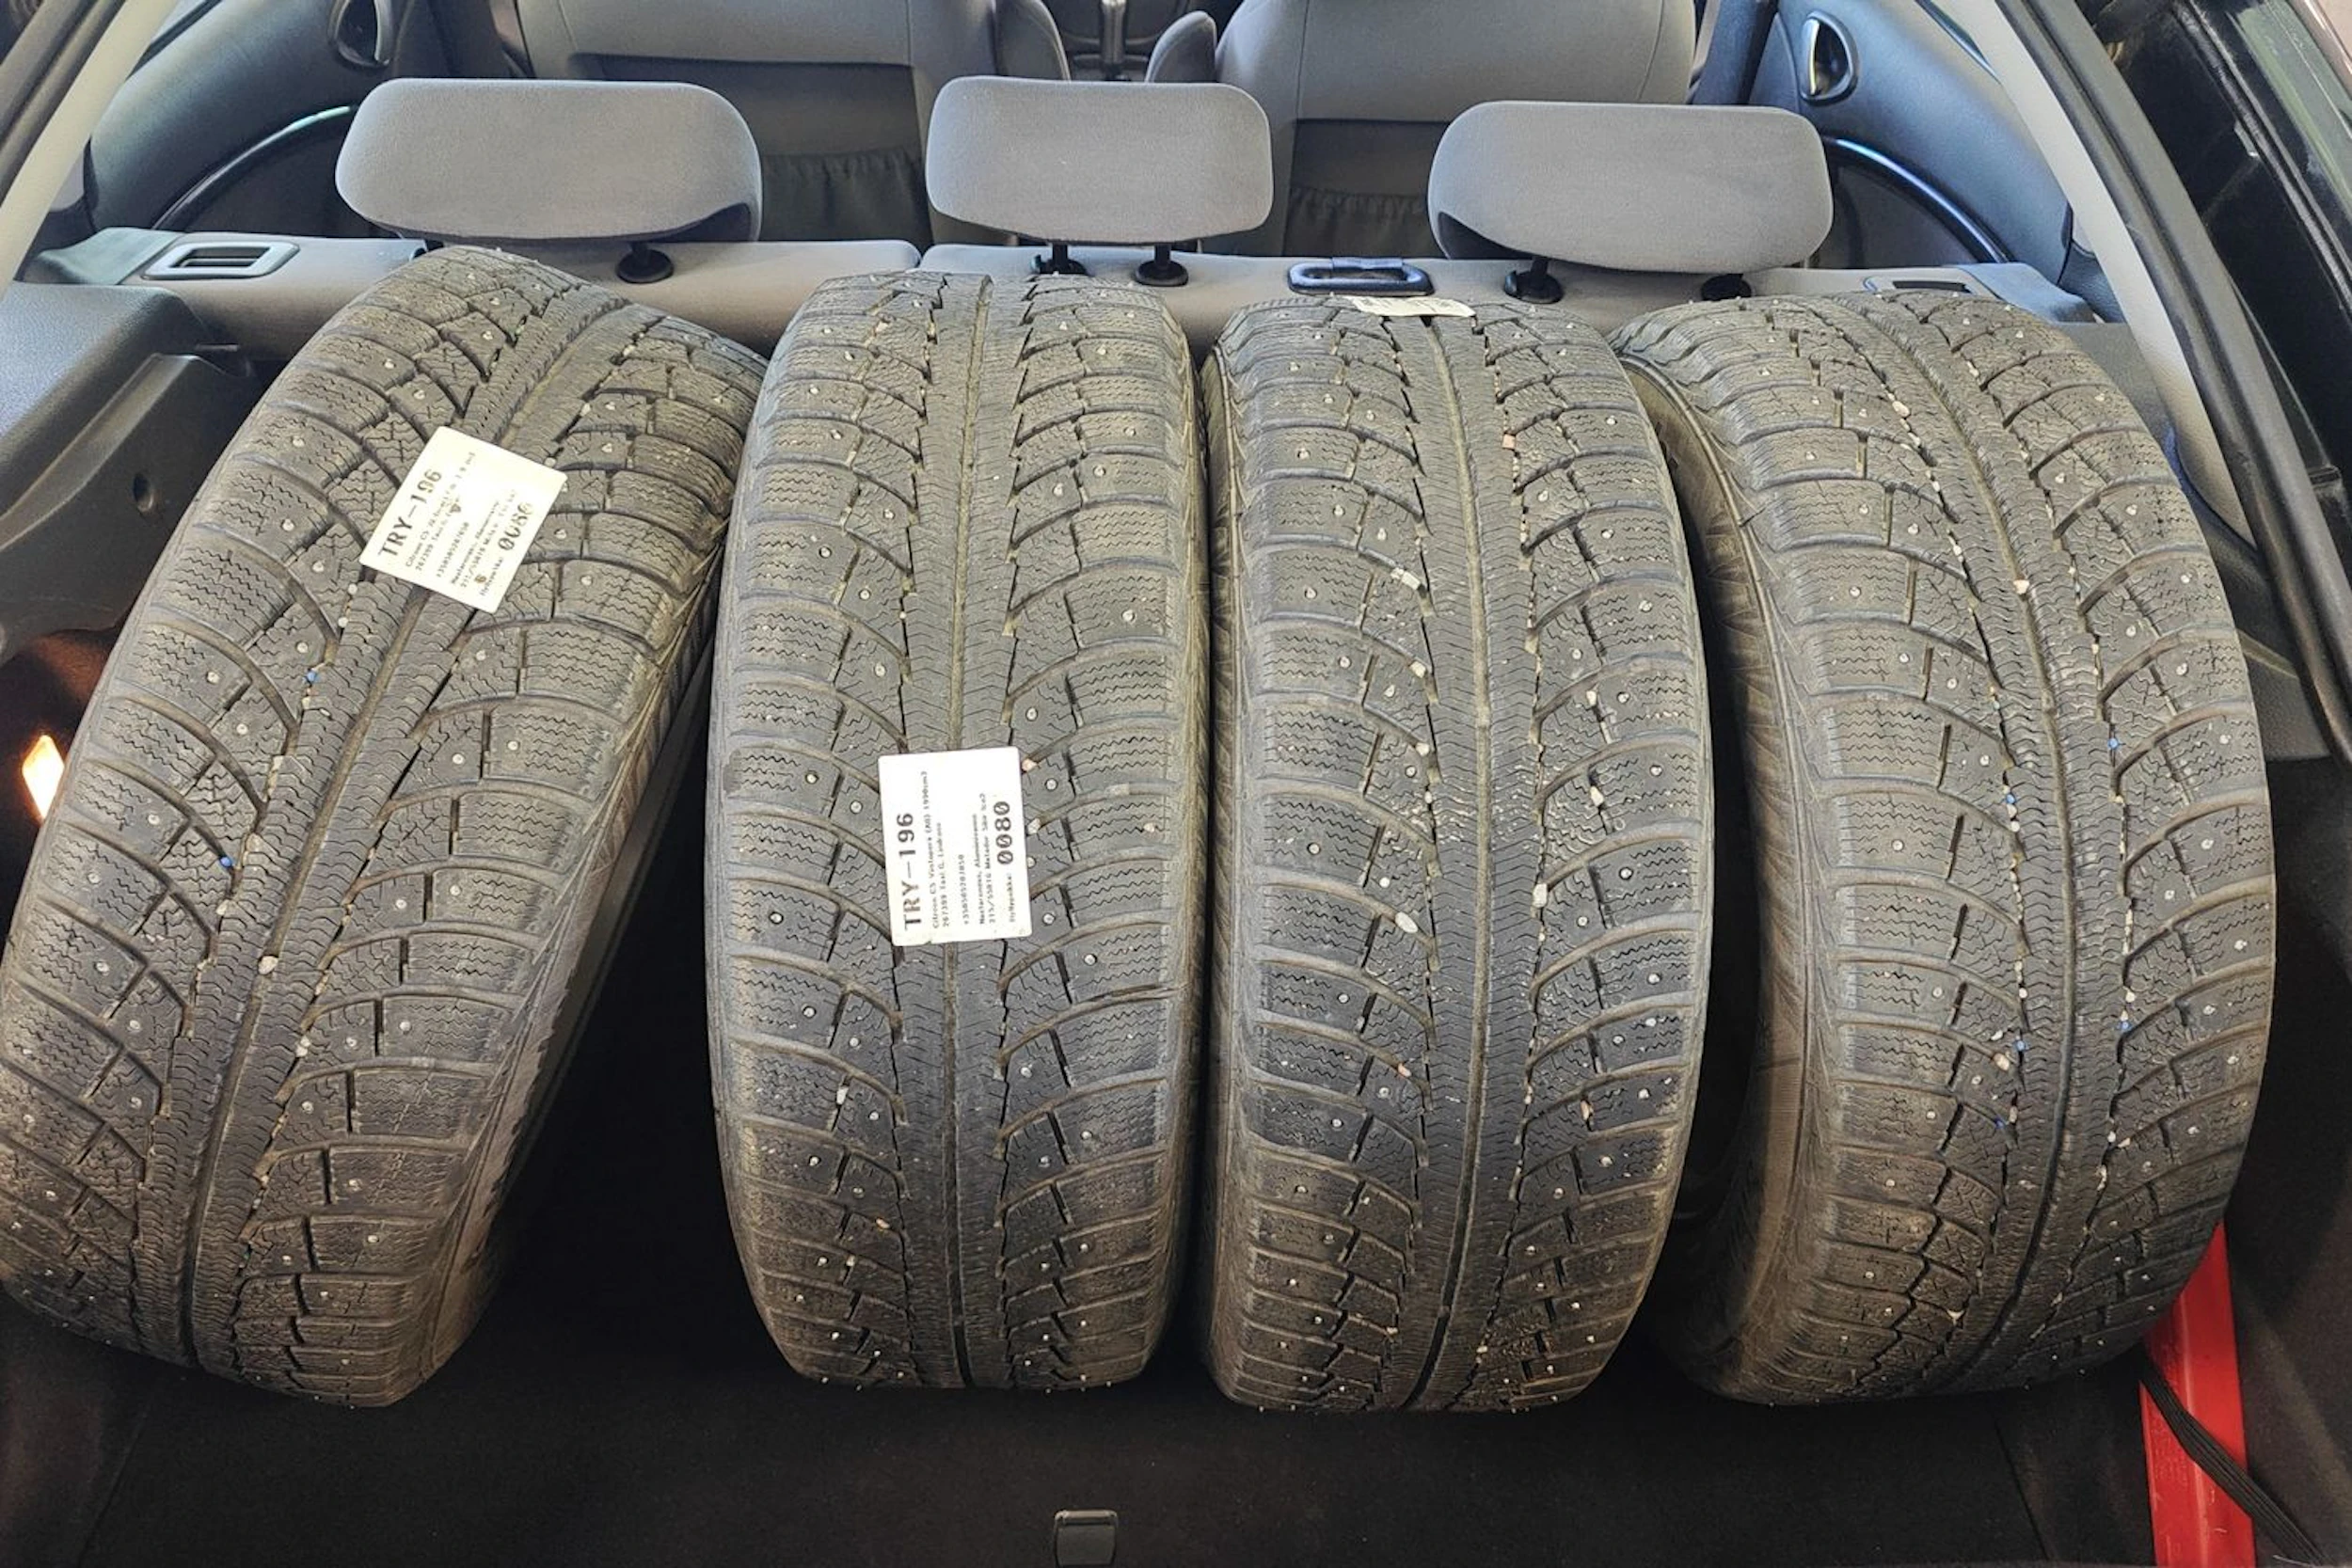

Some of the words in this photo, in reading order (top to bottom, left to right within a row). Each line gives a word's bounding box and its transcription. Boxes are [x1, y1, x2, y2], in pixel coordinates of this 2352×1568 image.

[376, 467, 444, 561] TRY-196
[896, 812, 922, 930] TRY-196
[993, 800, 1013, 865] 0080
